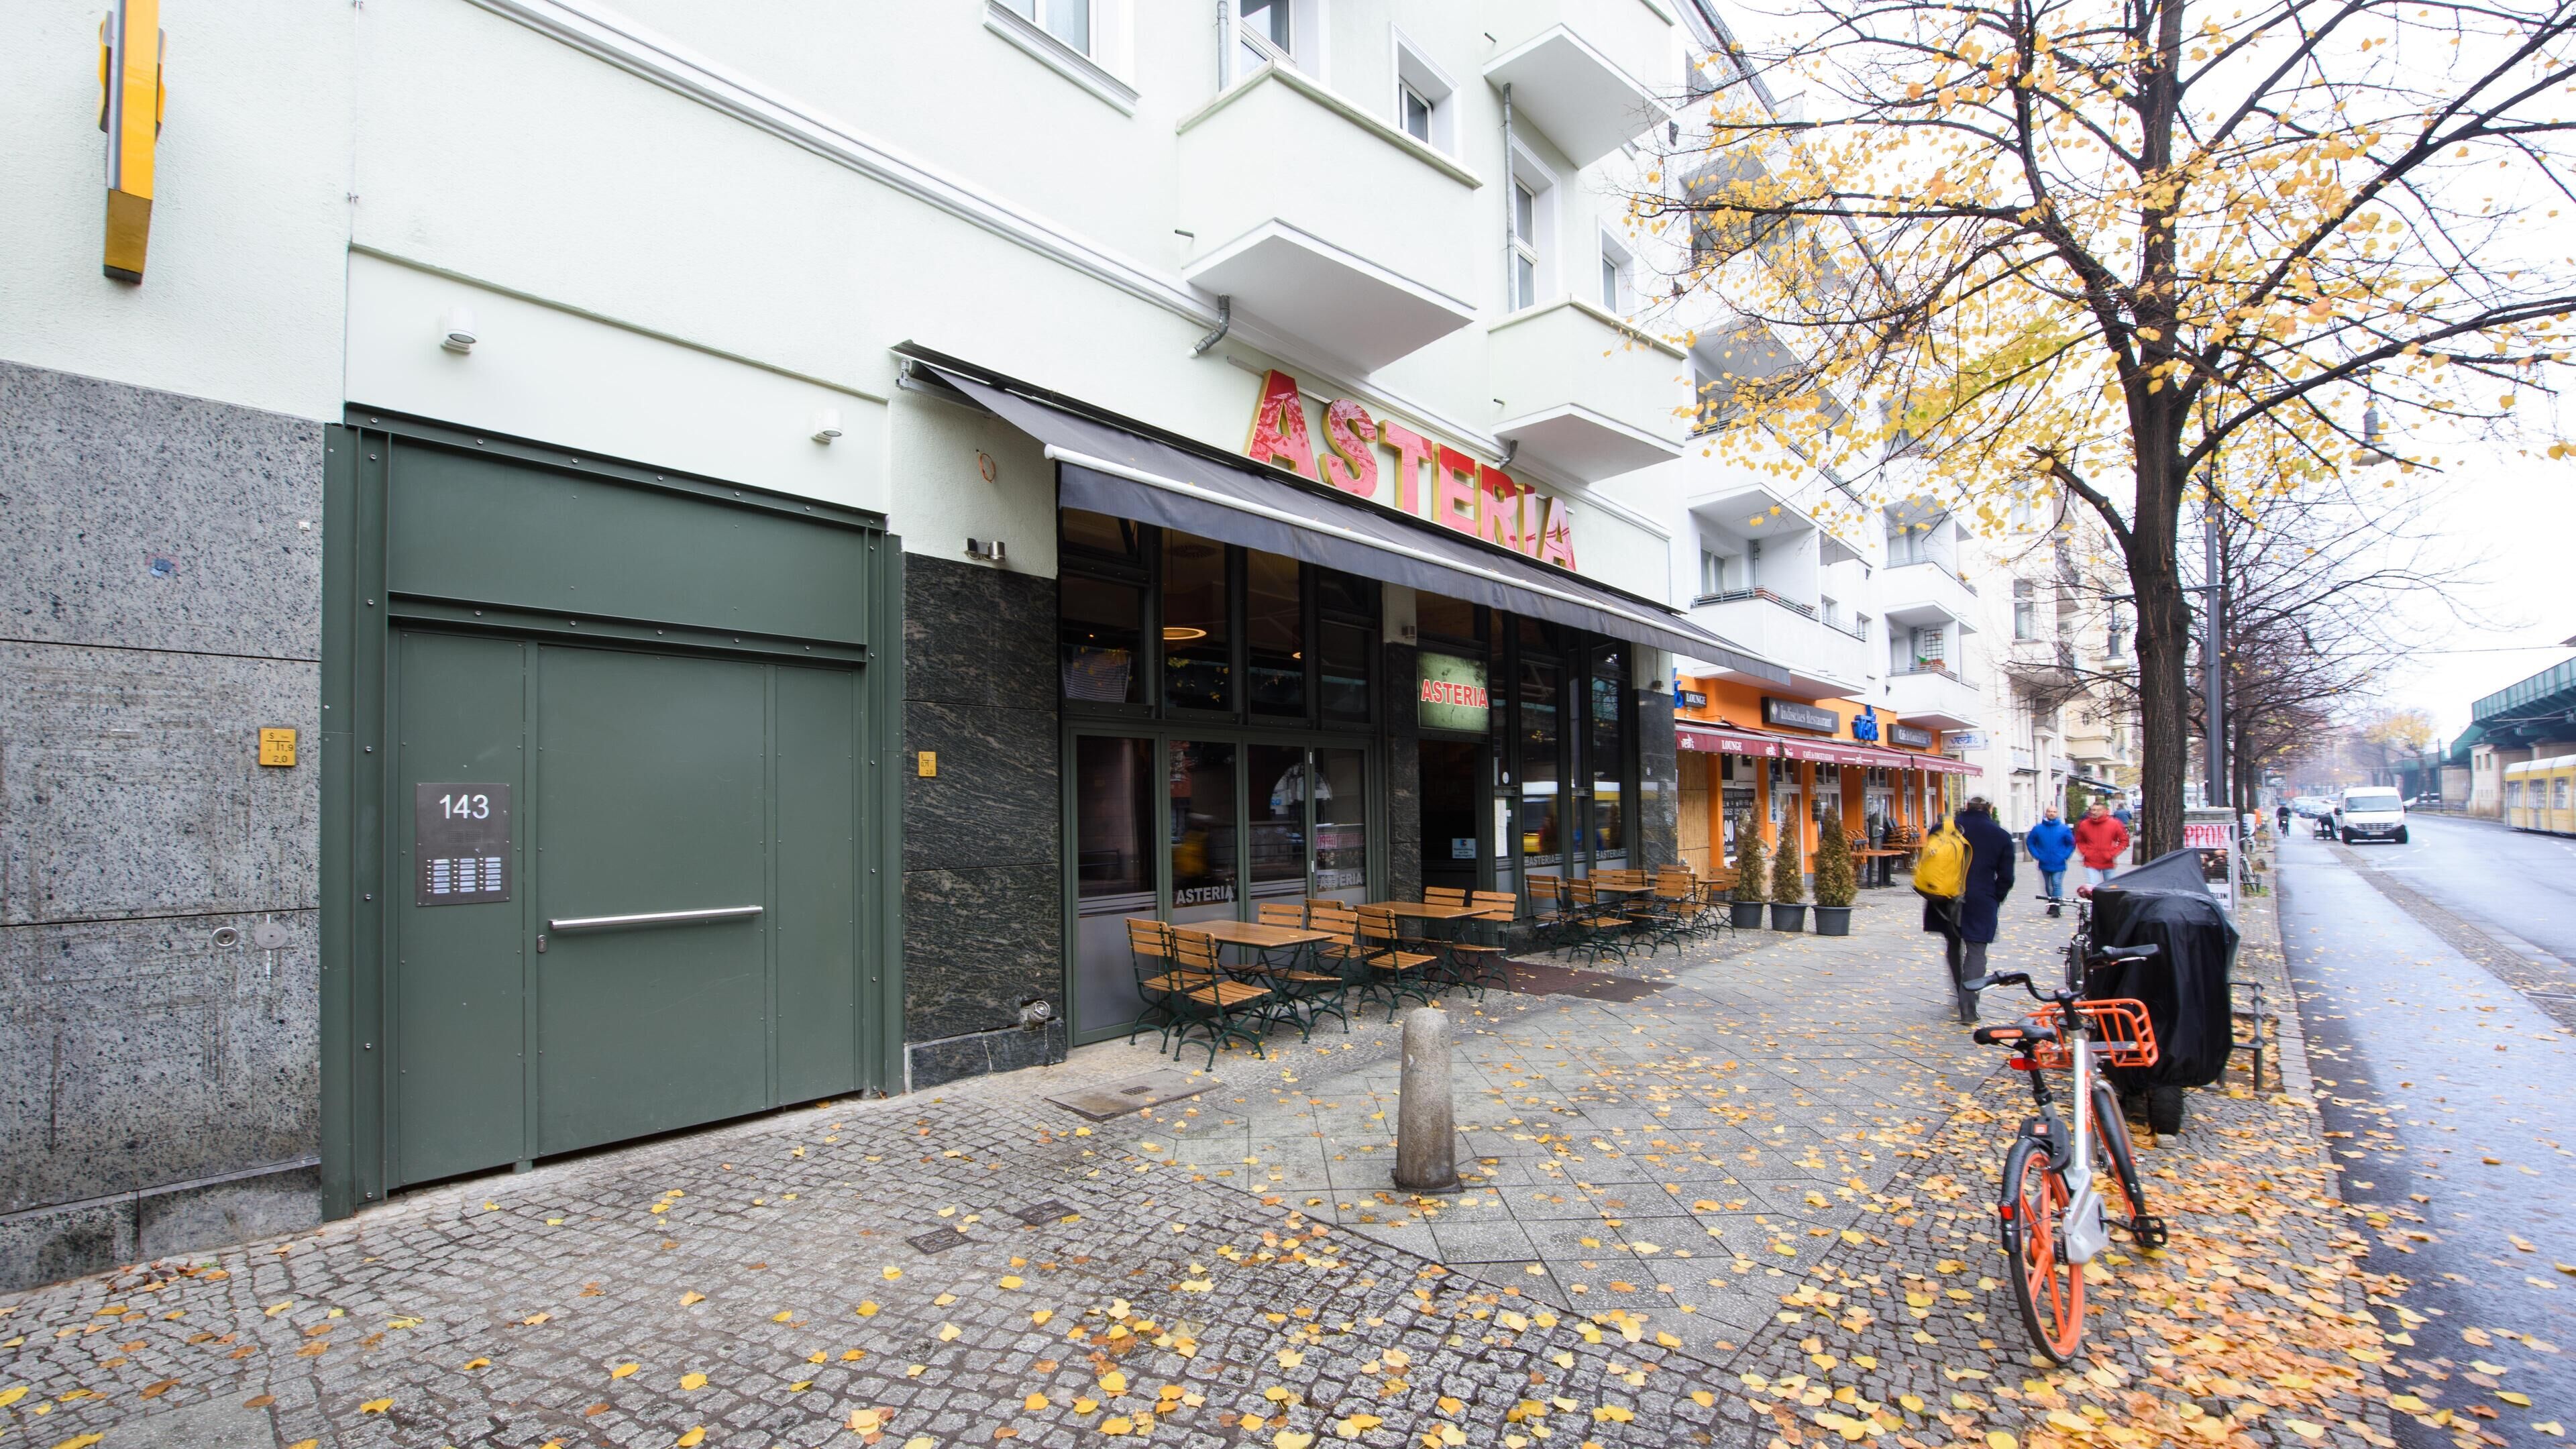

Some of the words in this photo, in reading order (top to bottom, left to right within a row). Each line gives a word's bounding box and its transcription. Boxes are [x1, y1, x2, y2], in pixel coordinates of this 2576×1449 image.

[1244, 369, 1576, 572] ASTERIA
[1421, 679, 1489, 709] ASTERIA
[1686, 692, 1706, 705] LOUNGE
[1780, 705, 1806, 722] Indisches
[1807, 710, 1833, 728] Restaurant
[1721, 740, 1743, 751] LOUNGE
[439, 794, 490, 819] 143
[1529, 855, 1556, 866] ASTERIA
[1599, 849, 1622, 859] ASTERIA
[1320, 872, 1364, 889] ASTERIA
[1176, 885, 1235, 904] ASTERIA
